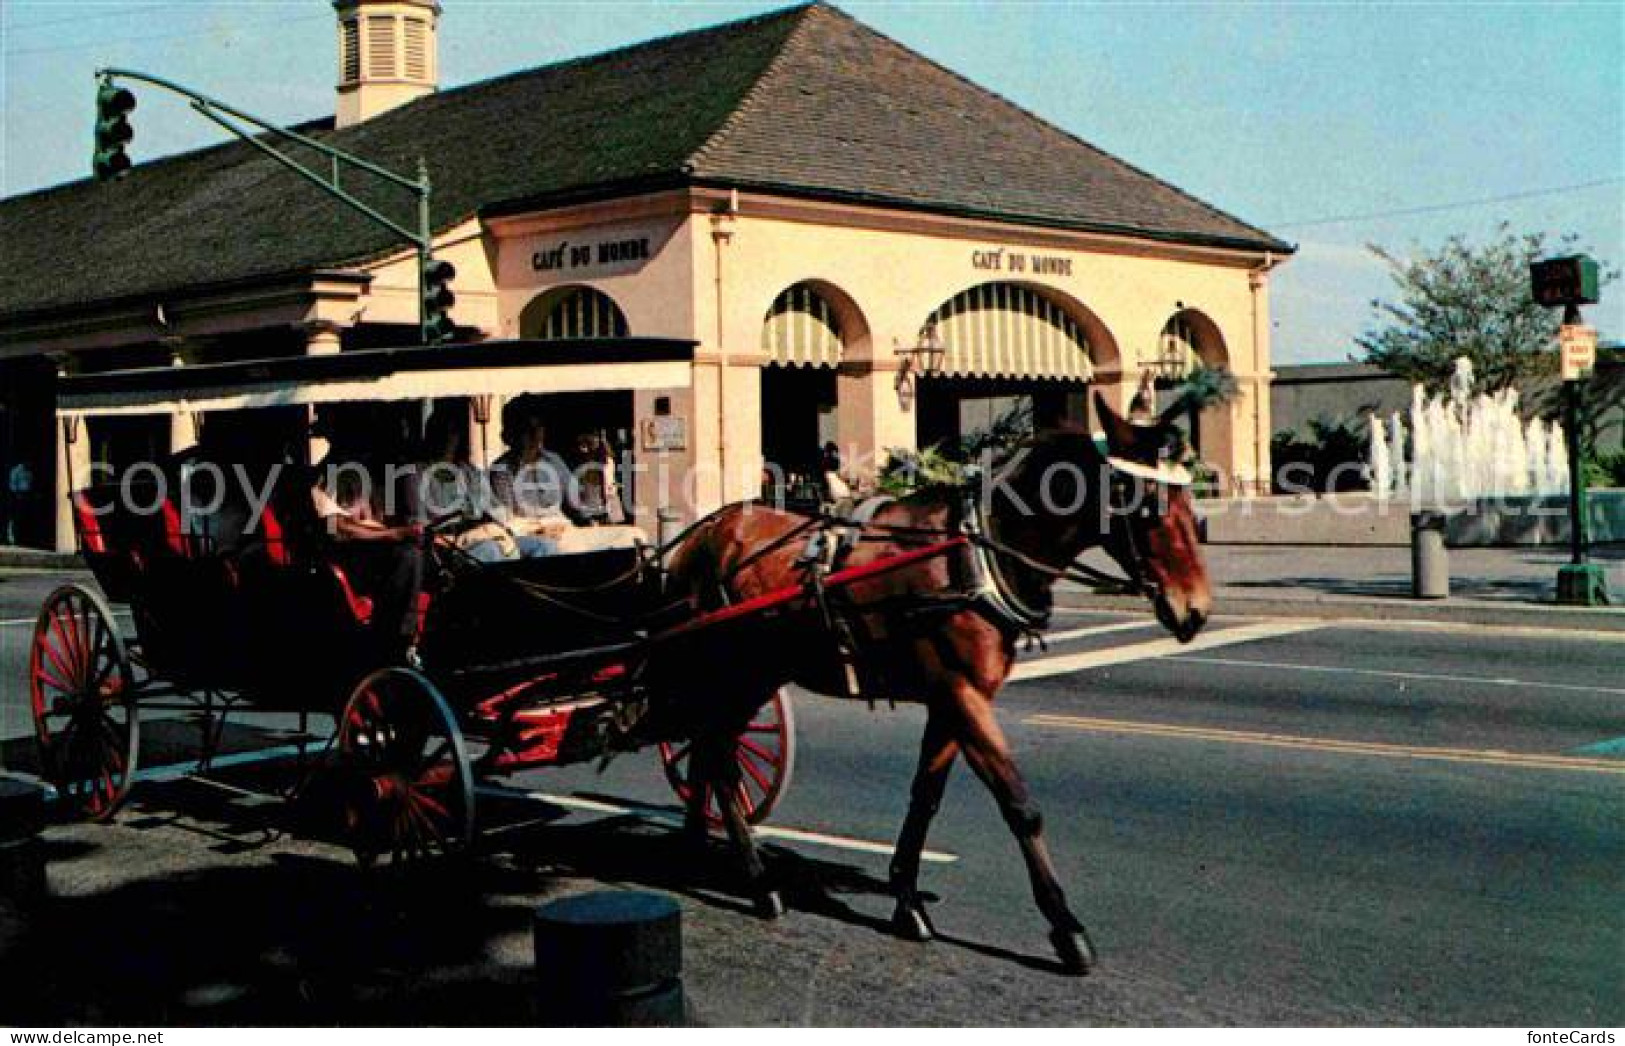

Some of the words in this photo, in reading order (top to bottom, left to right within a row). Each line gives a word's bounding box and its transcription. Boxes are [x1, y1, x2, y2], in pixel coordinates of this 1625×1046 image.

[532, 241, 568, 271] CAFÉ
[570, 245, 591, 268] DU
[598, 238, 650, 263] MONDE
[972, 247, 1005, 270] CAFÉ
[1008, 253, 1026, 273] DU
[1031, 254, 1073, 277] MONDE
